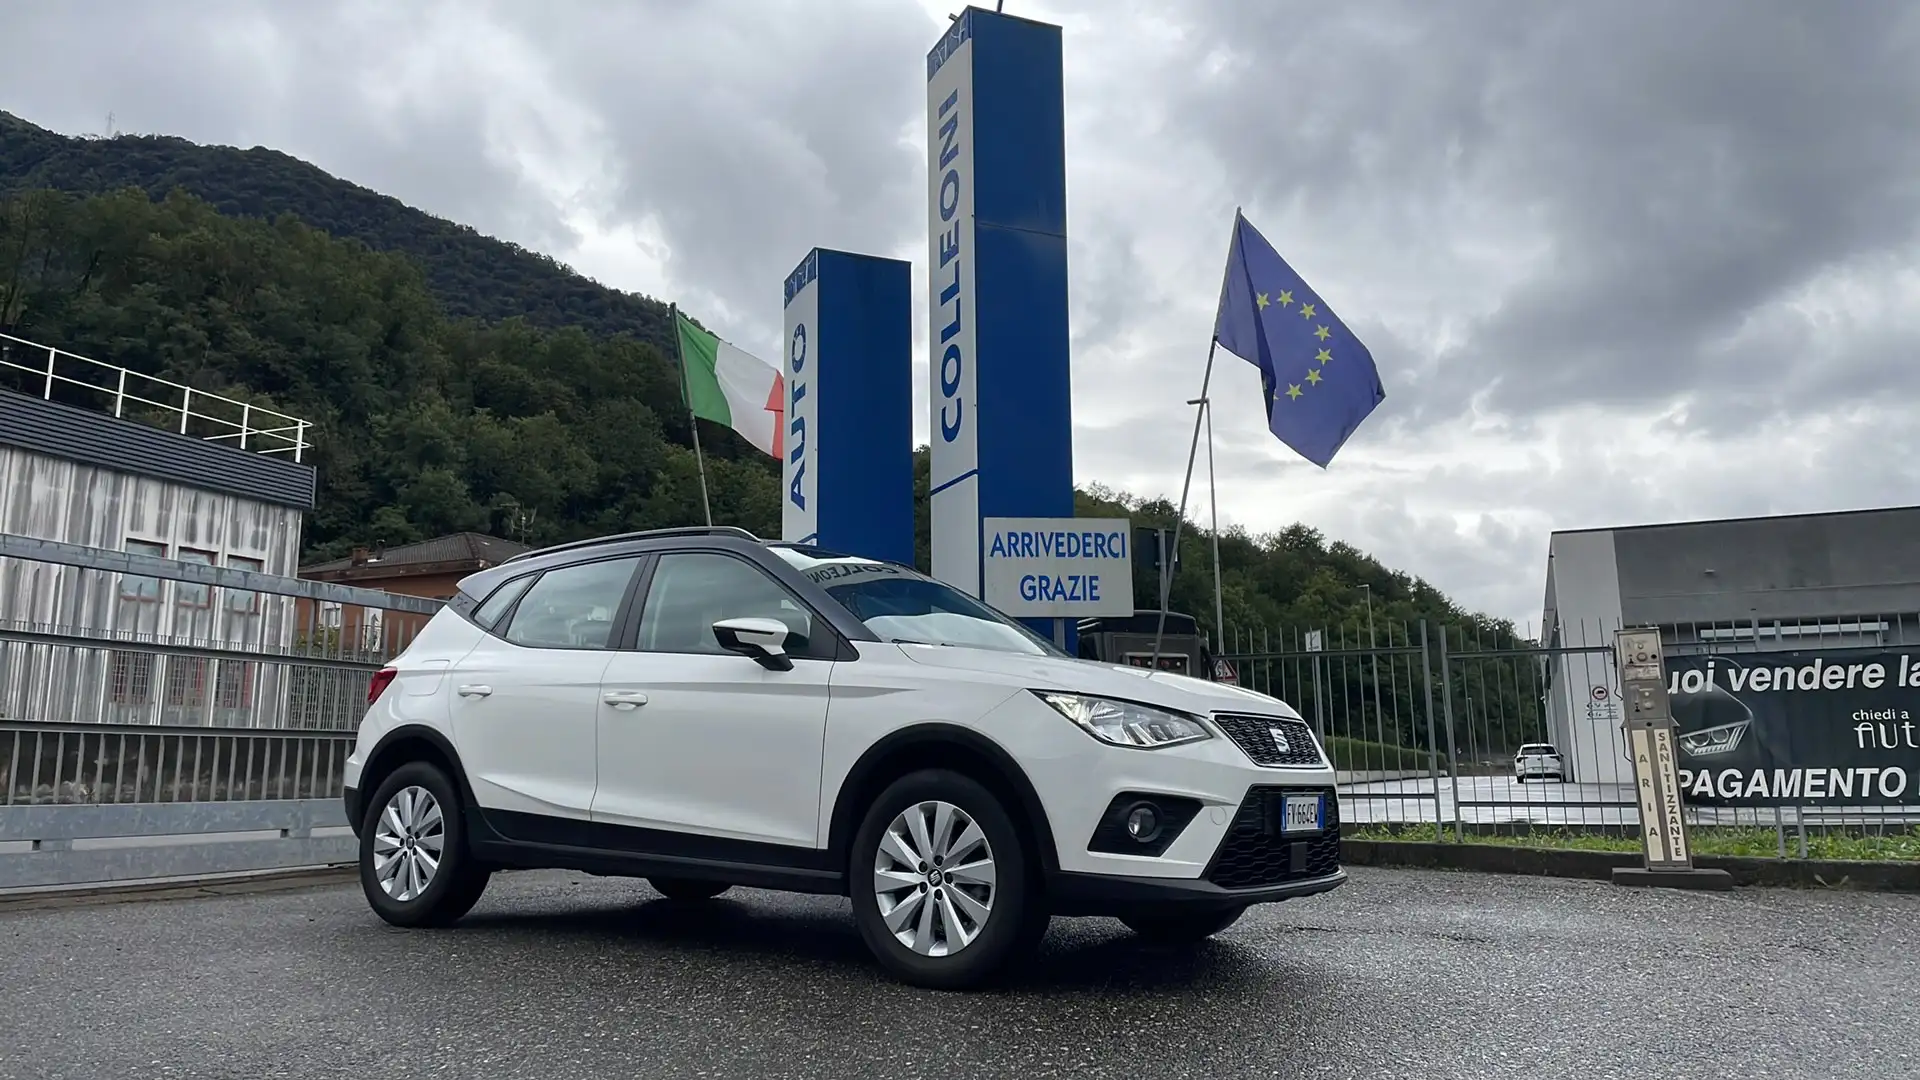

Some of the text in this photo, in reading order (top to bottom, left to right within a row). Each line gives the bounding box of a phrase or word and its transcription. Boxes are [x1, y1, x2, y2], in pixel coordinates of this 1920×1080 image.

[938, 88, 962, 443] COLLEONI
[790, 323, 807, 512] AUTO
[989, 531, 1126, 559] ARRIVEDERCI
[1019, 574, 1101, 602] GRAZIE
[1727, 658, 1886, 692] vendere
[1852, 708, 1910, 721] chiedi a
[1638, 754, 1658, 837] ARIA
[1658, 732, 1683, 857] SANITIZZANTE
[1679, 766, 1907, 799] PAGAMENTO
